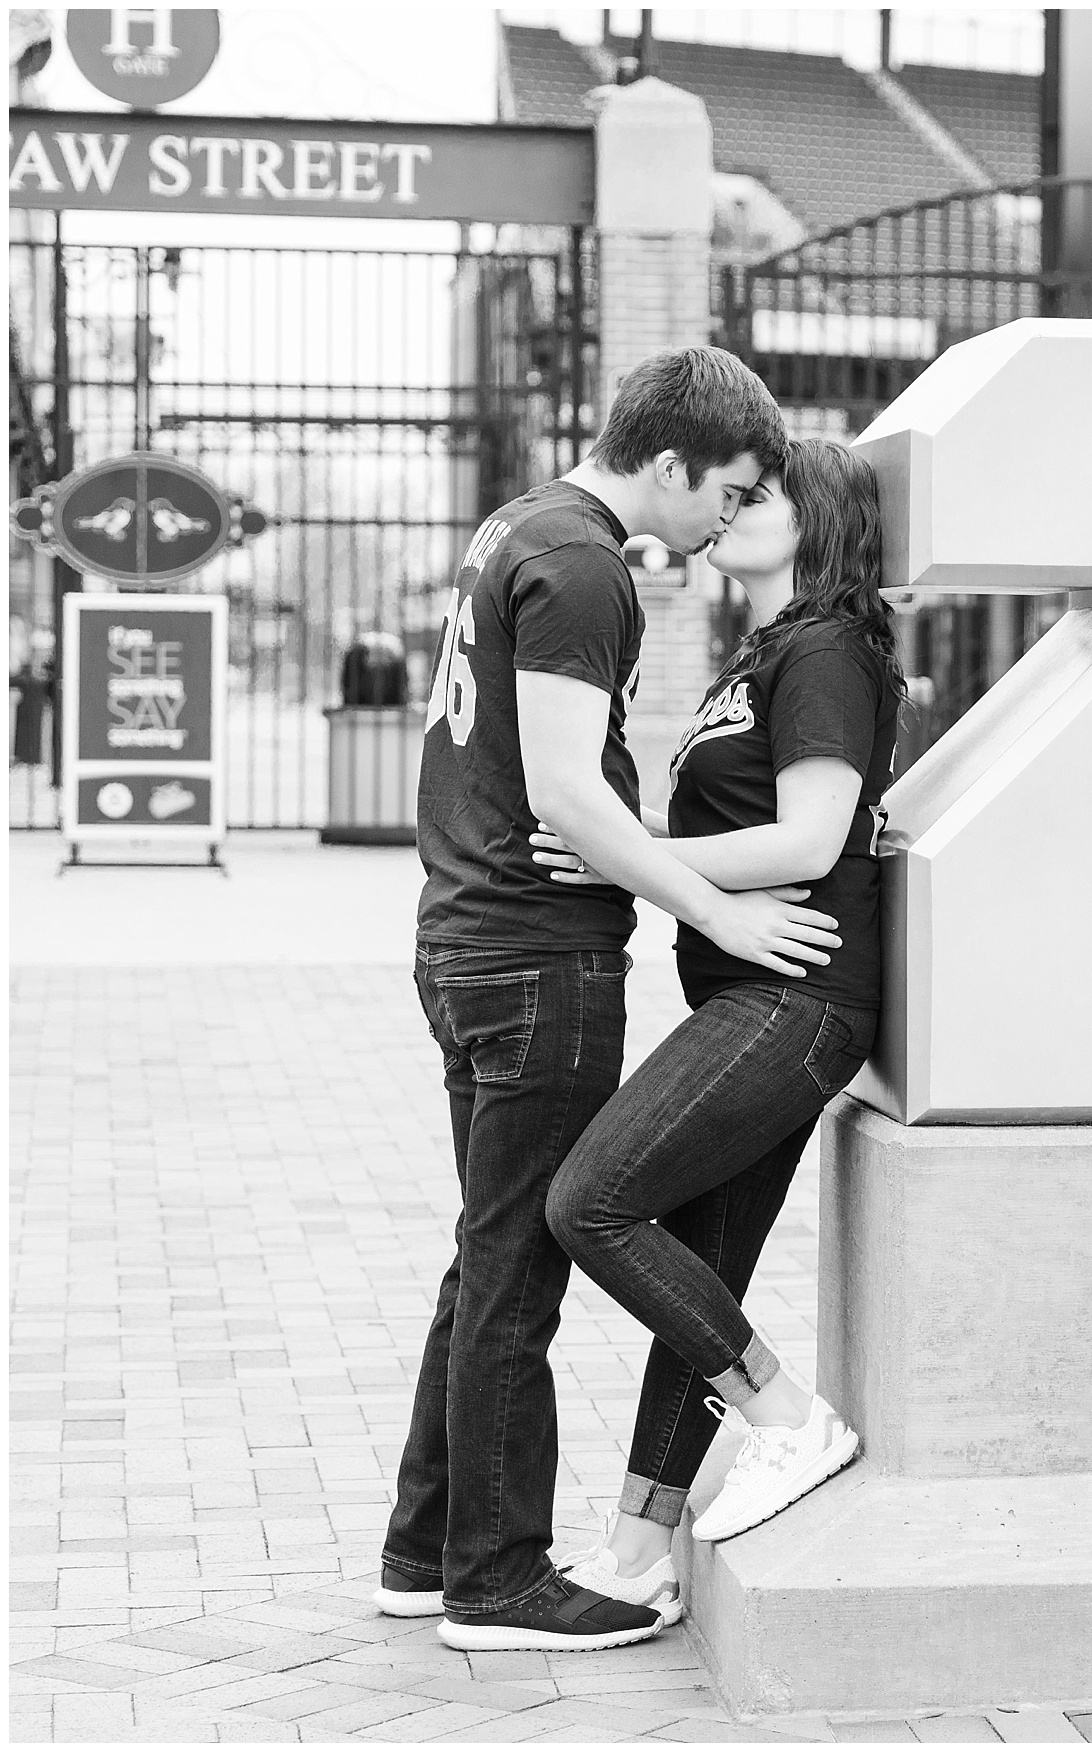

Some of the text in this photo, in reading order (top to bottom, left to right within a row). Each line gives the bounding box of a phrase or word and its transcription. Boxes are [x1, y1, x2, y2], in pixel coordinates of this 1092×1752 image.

[102, 8, 181, 57] H
[9, 131, 432, 202] AW STREET
[107, 641, 183, 680] SEE
[107, 695, 187, 730] SAY
